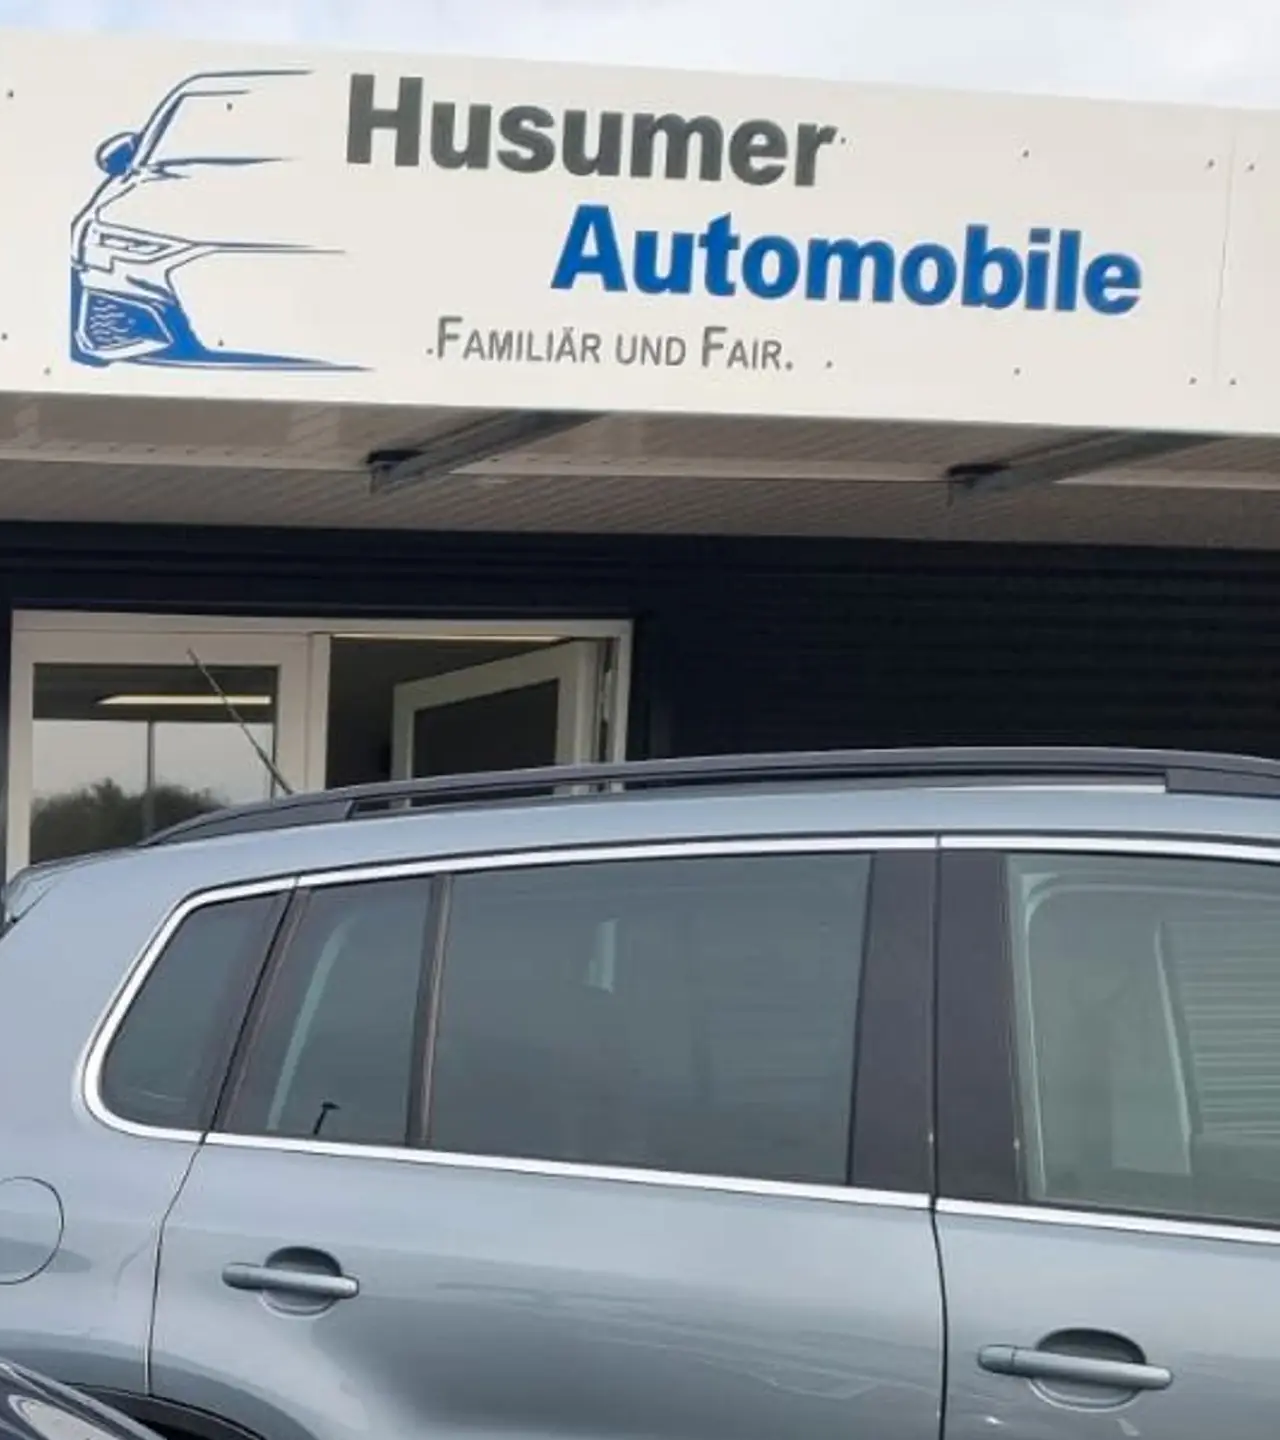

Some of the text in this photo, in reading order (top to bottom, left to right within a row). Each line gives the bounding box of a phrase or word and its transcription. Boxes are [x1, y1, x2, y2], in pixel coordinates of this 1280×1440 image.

[346, 73, 839, 187] Husumer
[550, 203, 1143, 316] Automobile
[437, 316, 602, 365] FAMILIÄR
[615, 333, 687, 367] UND
